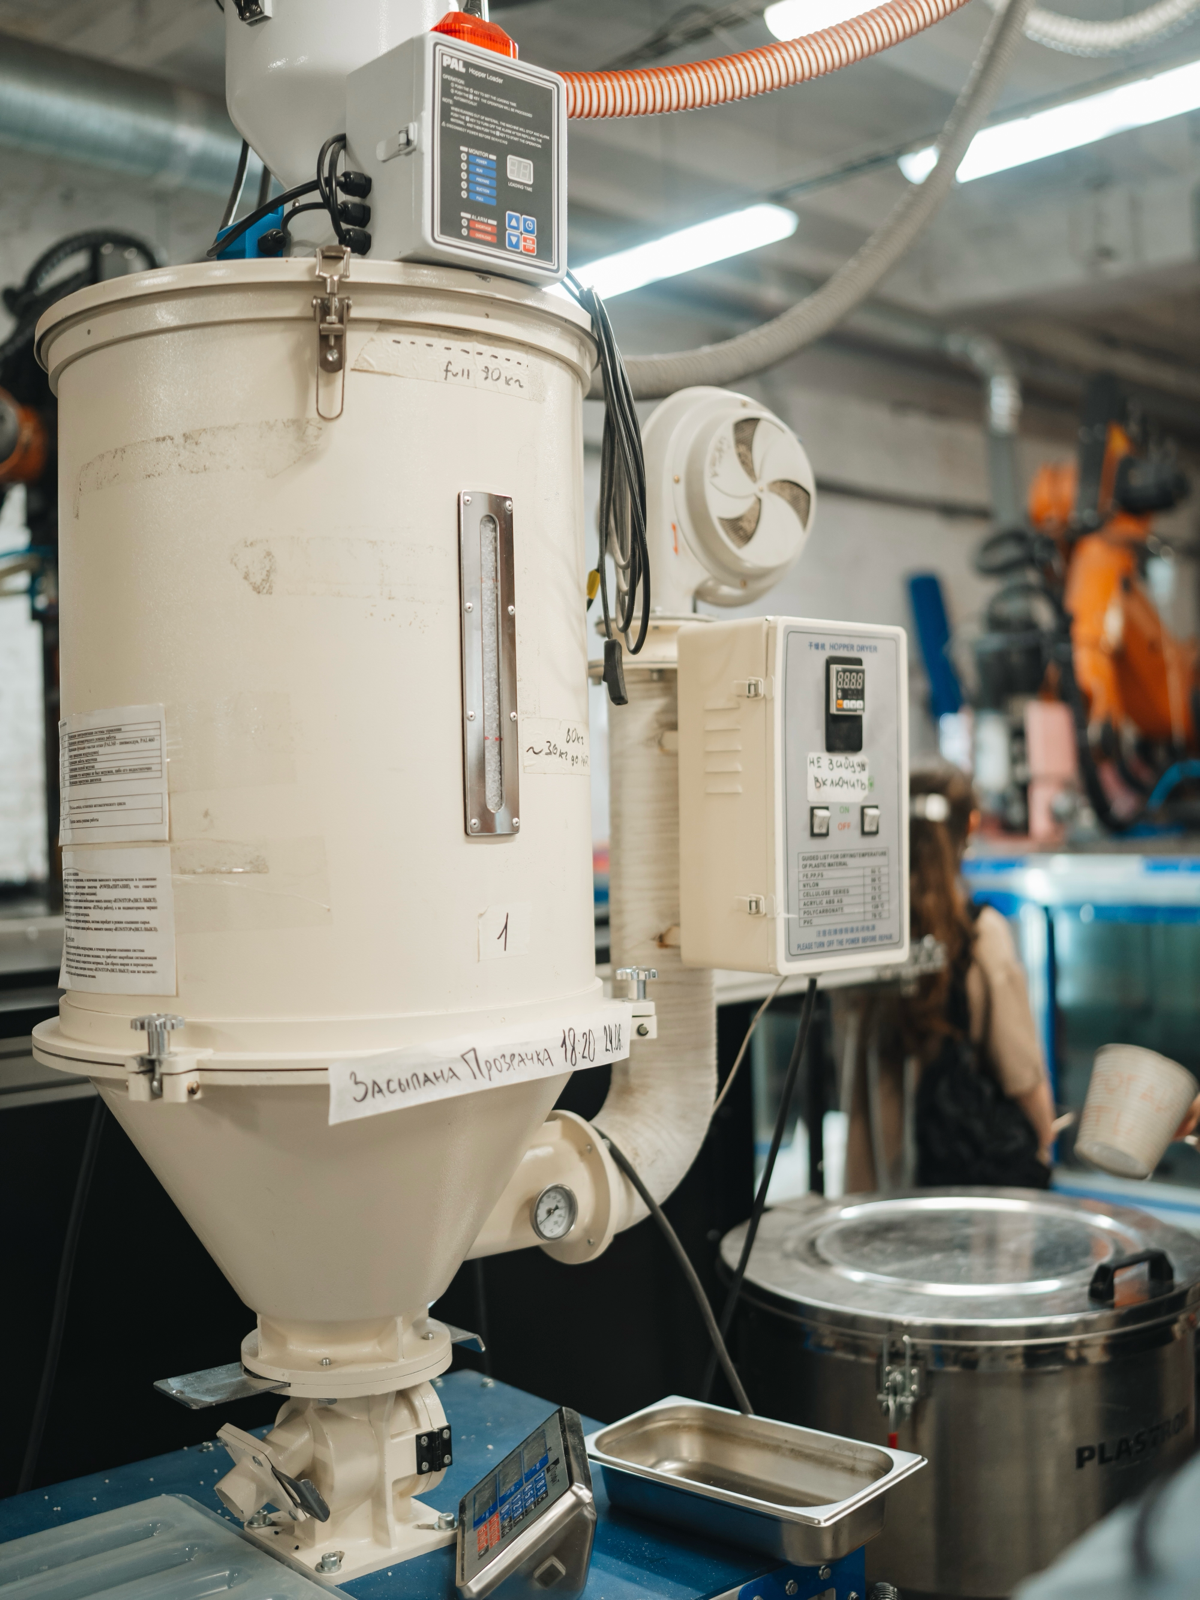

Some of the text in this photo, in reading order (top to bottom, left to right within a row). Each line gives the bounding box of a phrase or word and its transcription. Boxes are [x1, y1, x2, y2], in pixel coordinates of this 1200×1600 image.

[442, 54, 504, 84] PAL Hopper Loader
[469, 148, 488, 159] MONITOR
[476, 158, 487, 166] POWER
[508, 182, 524, 190] LOADING
[471, 214, 488, 223] ALARM
[829, 642, 854, 652] HOPPER
[856, 643, 877, 653] DRYER
[839, 806, 850, 814] ON
[838, 822, 851, 831] OFF
[802, 854, 819, 862] GUIDED
[803, 890, 831, 898] CELLULOSE
[803, 899, 824, 907] ACRYLIC
[803, 907, 844, 916] POLYCARBONATE
[497, 912, 508, 952] 1
[797, 941, 813, 951] PLEASE
[845, 937, 860, 945] POWER
[861, 935, 876, 943] BEFORE
